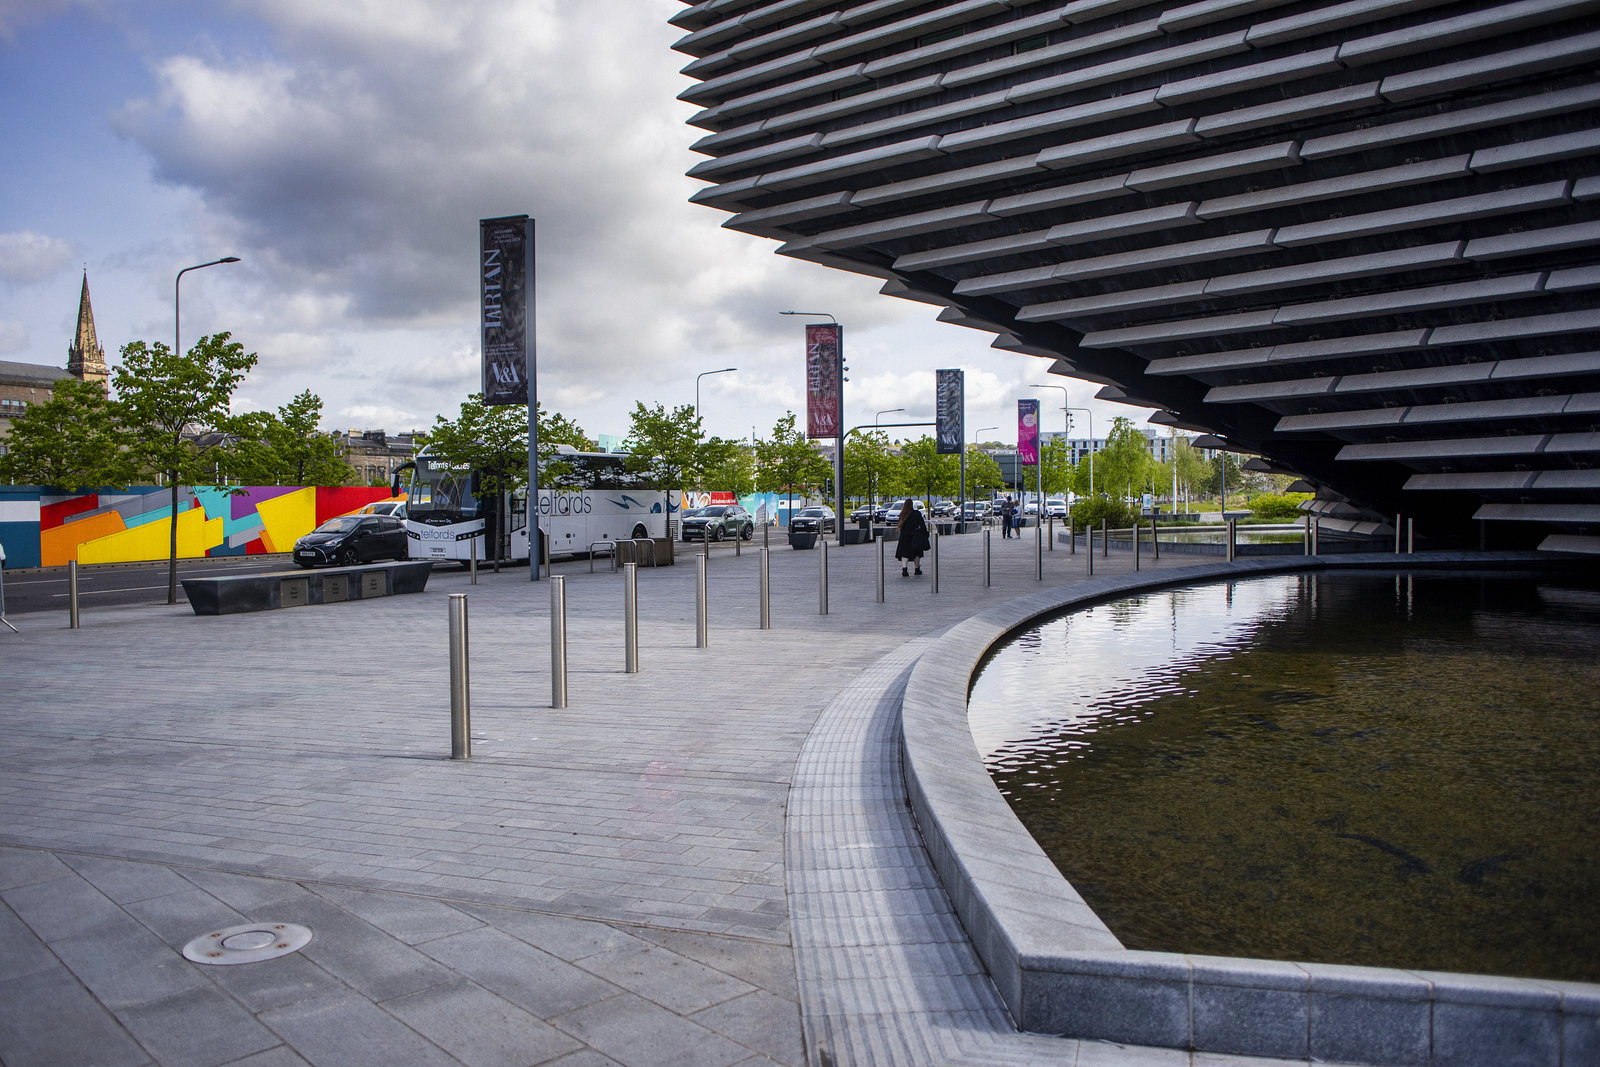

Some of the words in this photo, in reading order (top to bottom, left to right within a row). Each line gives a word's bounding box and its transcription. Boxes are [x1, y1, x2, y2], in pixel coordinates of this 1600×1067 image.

[492, 362, 520, 383] V&A
[814, 412, 833, 426] V&A
[539, 490, 592, 515] elfords
[421, 529, 455, 540] telfords
